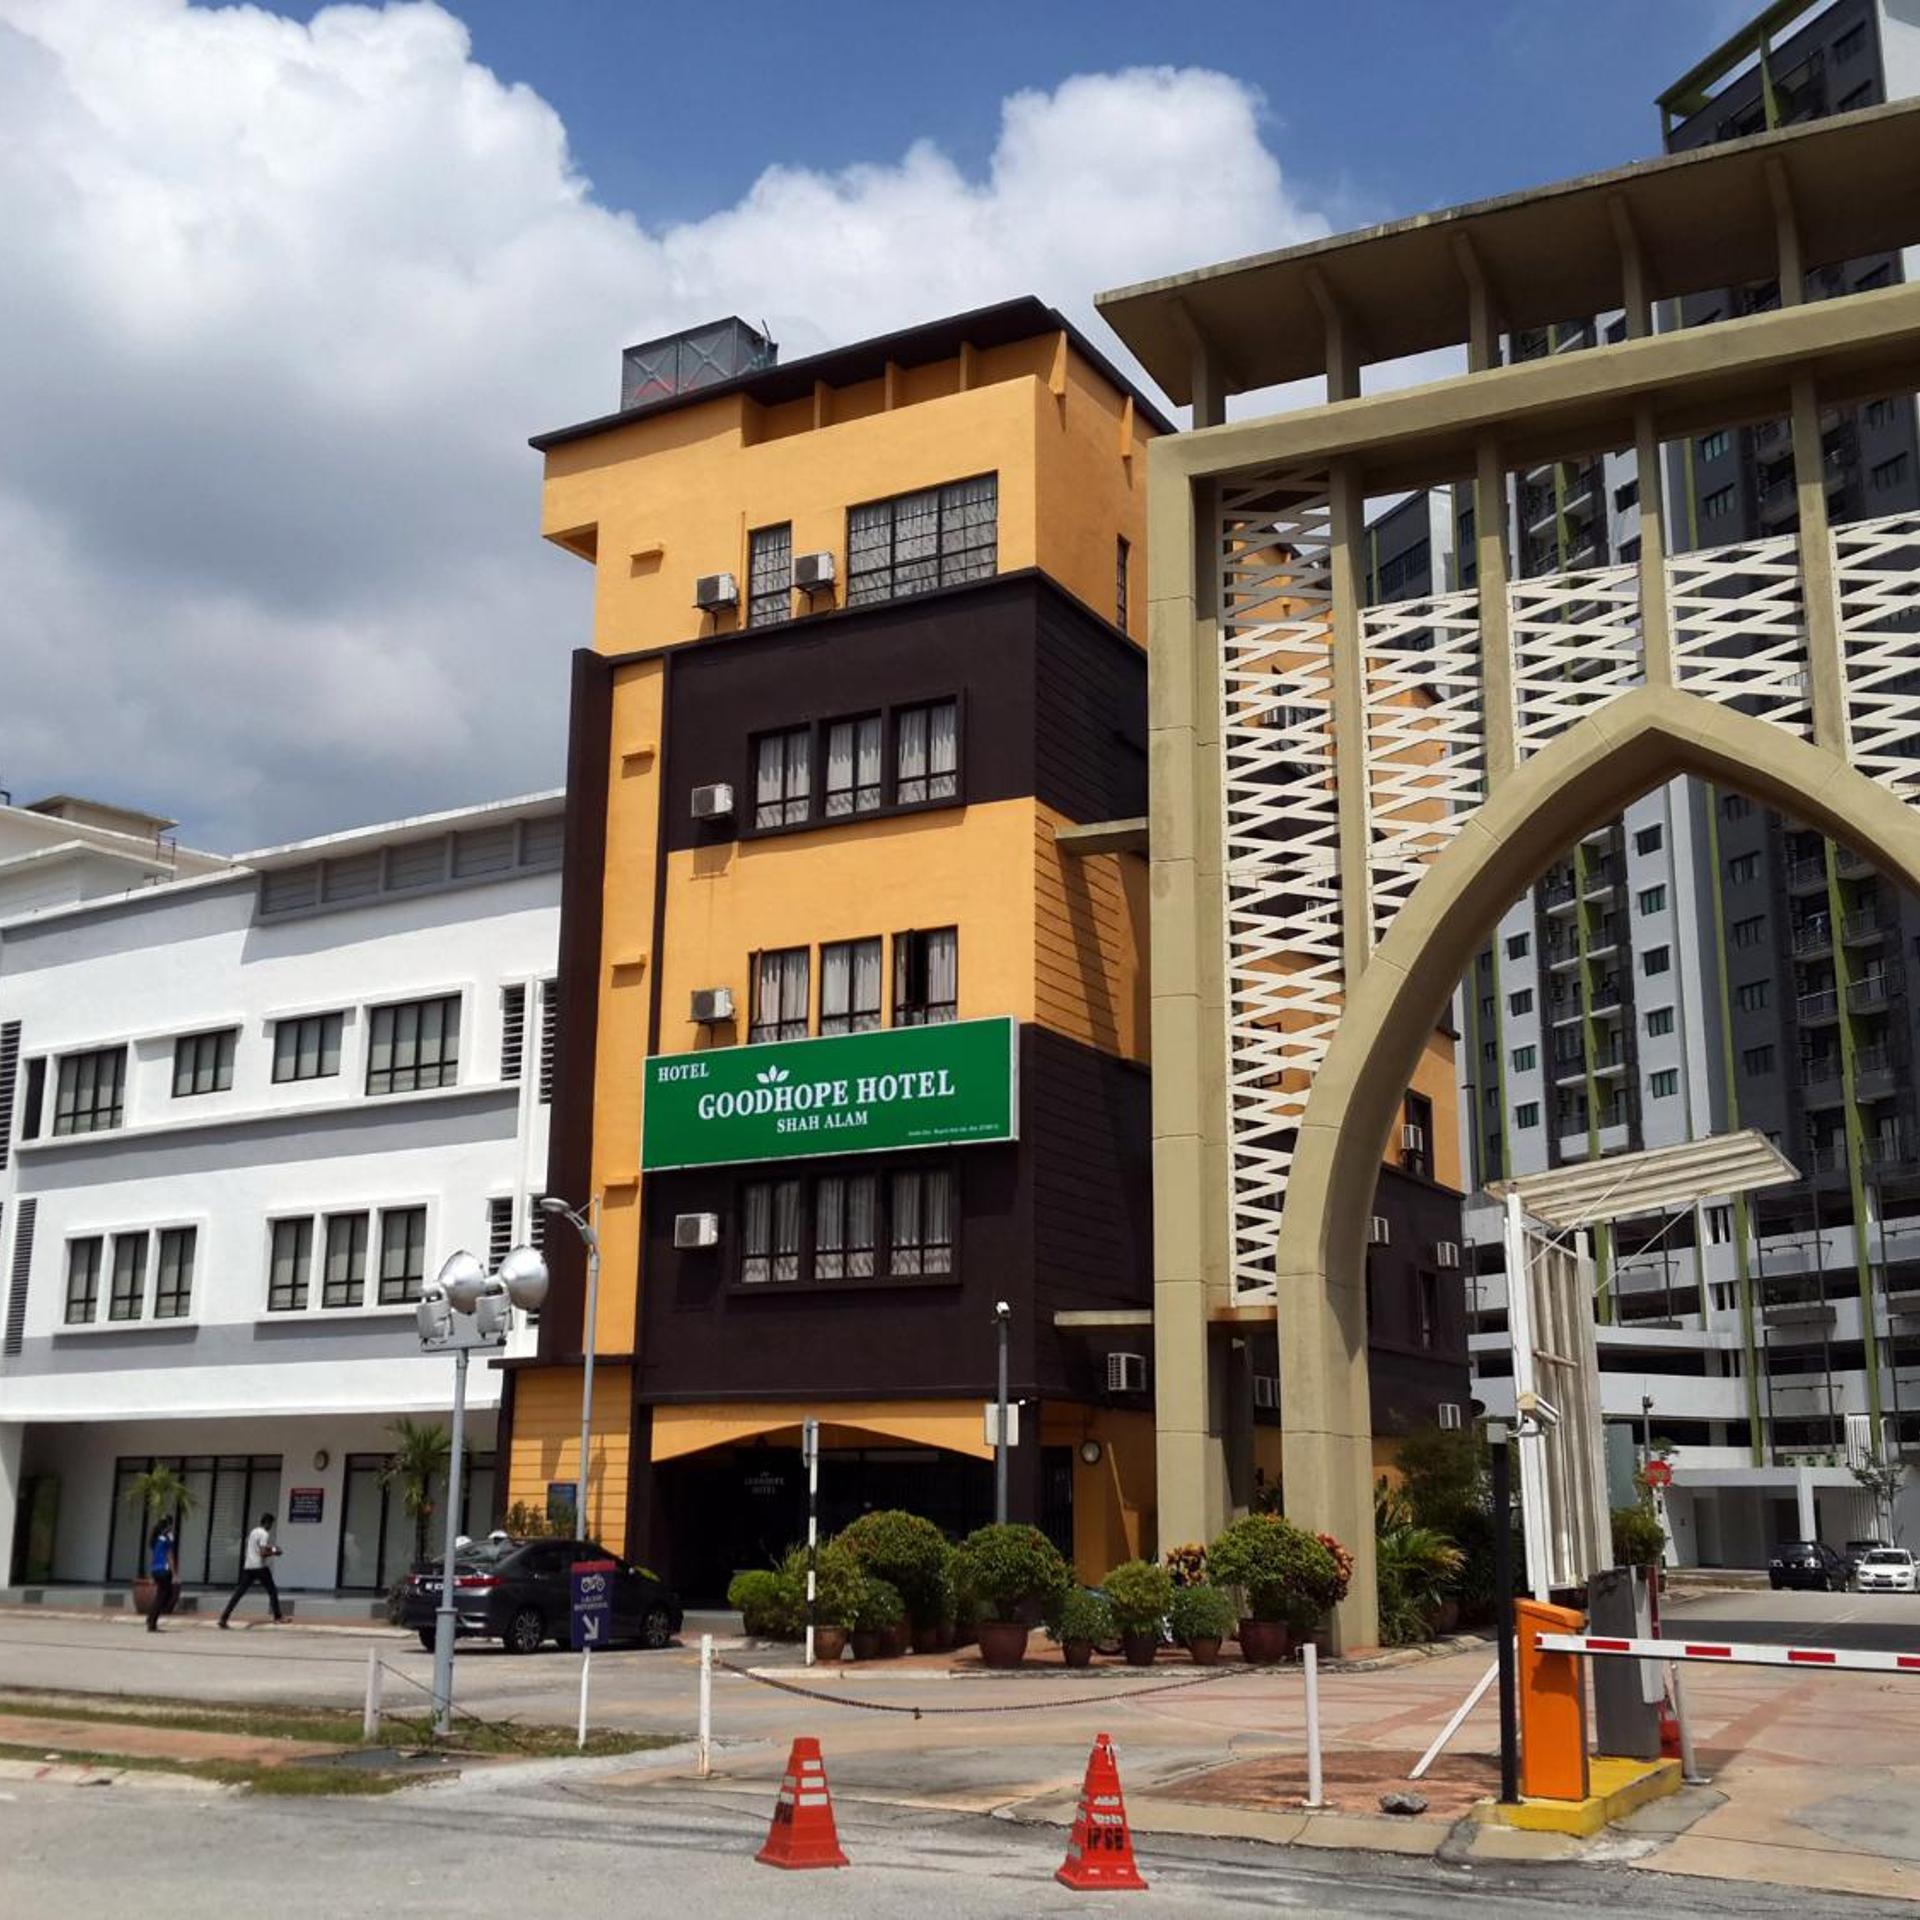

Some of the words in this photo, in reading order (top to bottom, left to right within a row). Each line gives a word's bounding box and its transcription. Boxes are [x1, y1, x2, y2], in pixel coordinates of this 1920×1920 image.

[658, 1063, 709, 1082] HOTEL
[698, 1080, 849, 1120] GOODHOPE
[856, 1069, 956, 1104] HOTEL
[776, 1115, 820, 1133] SHAH
[825, 1110, 869, 1129] ALAM
